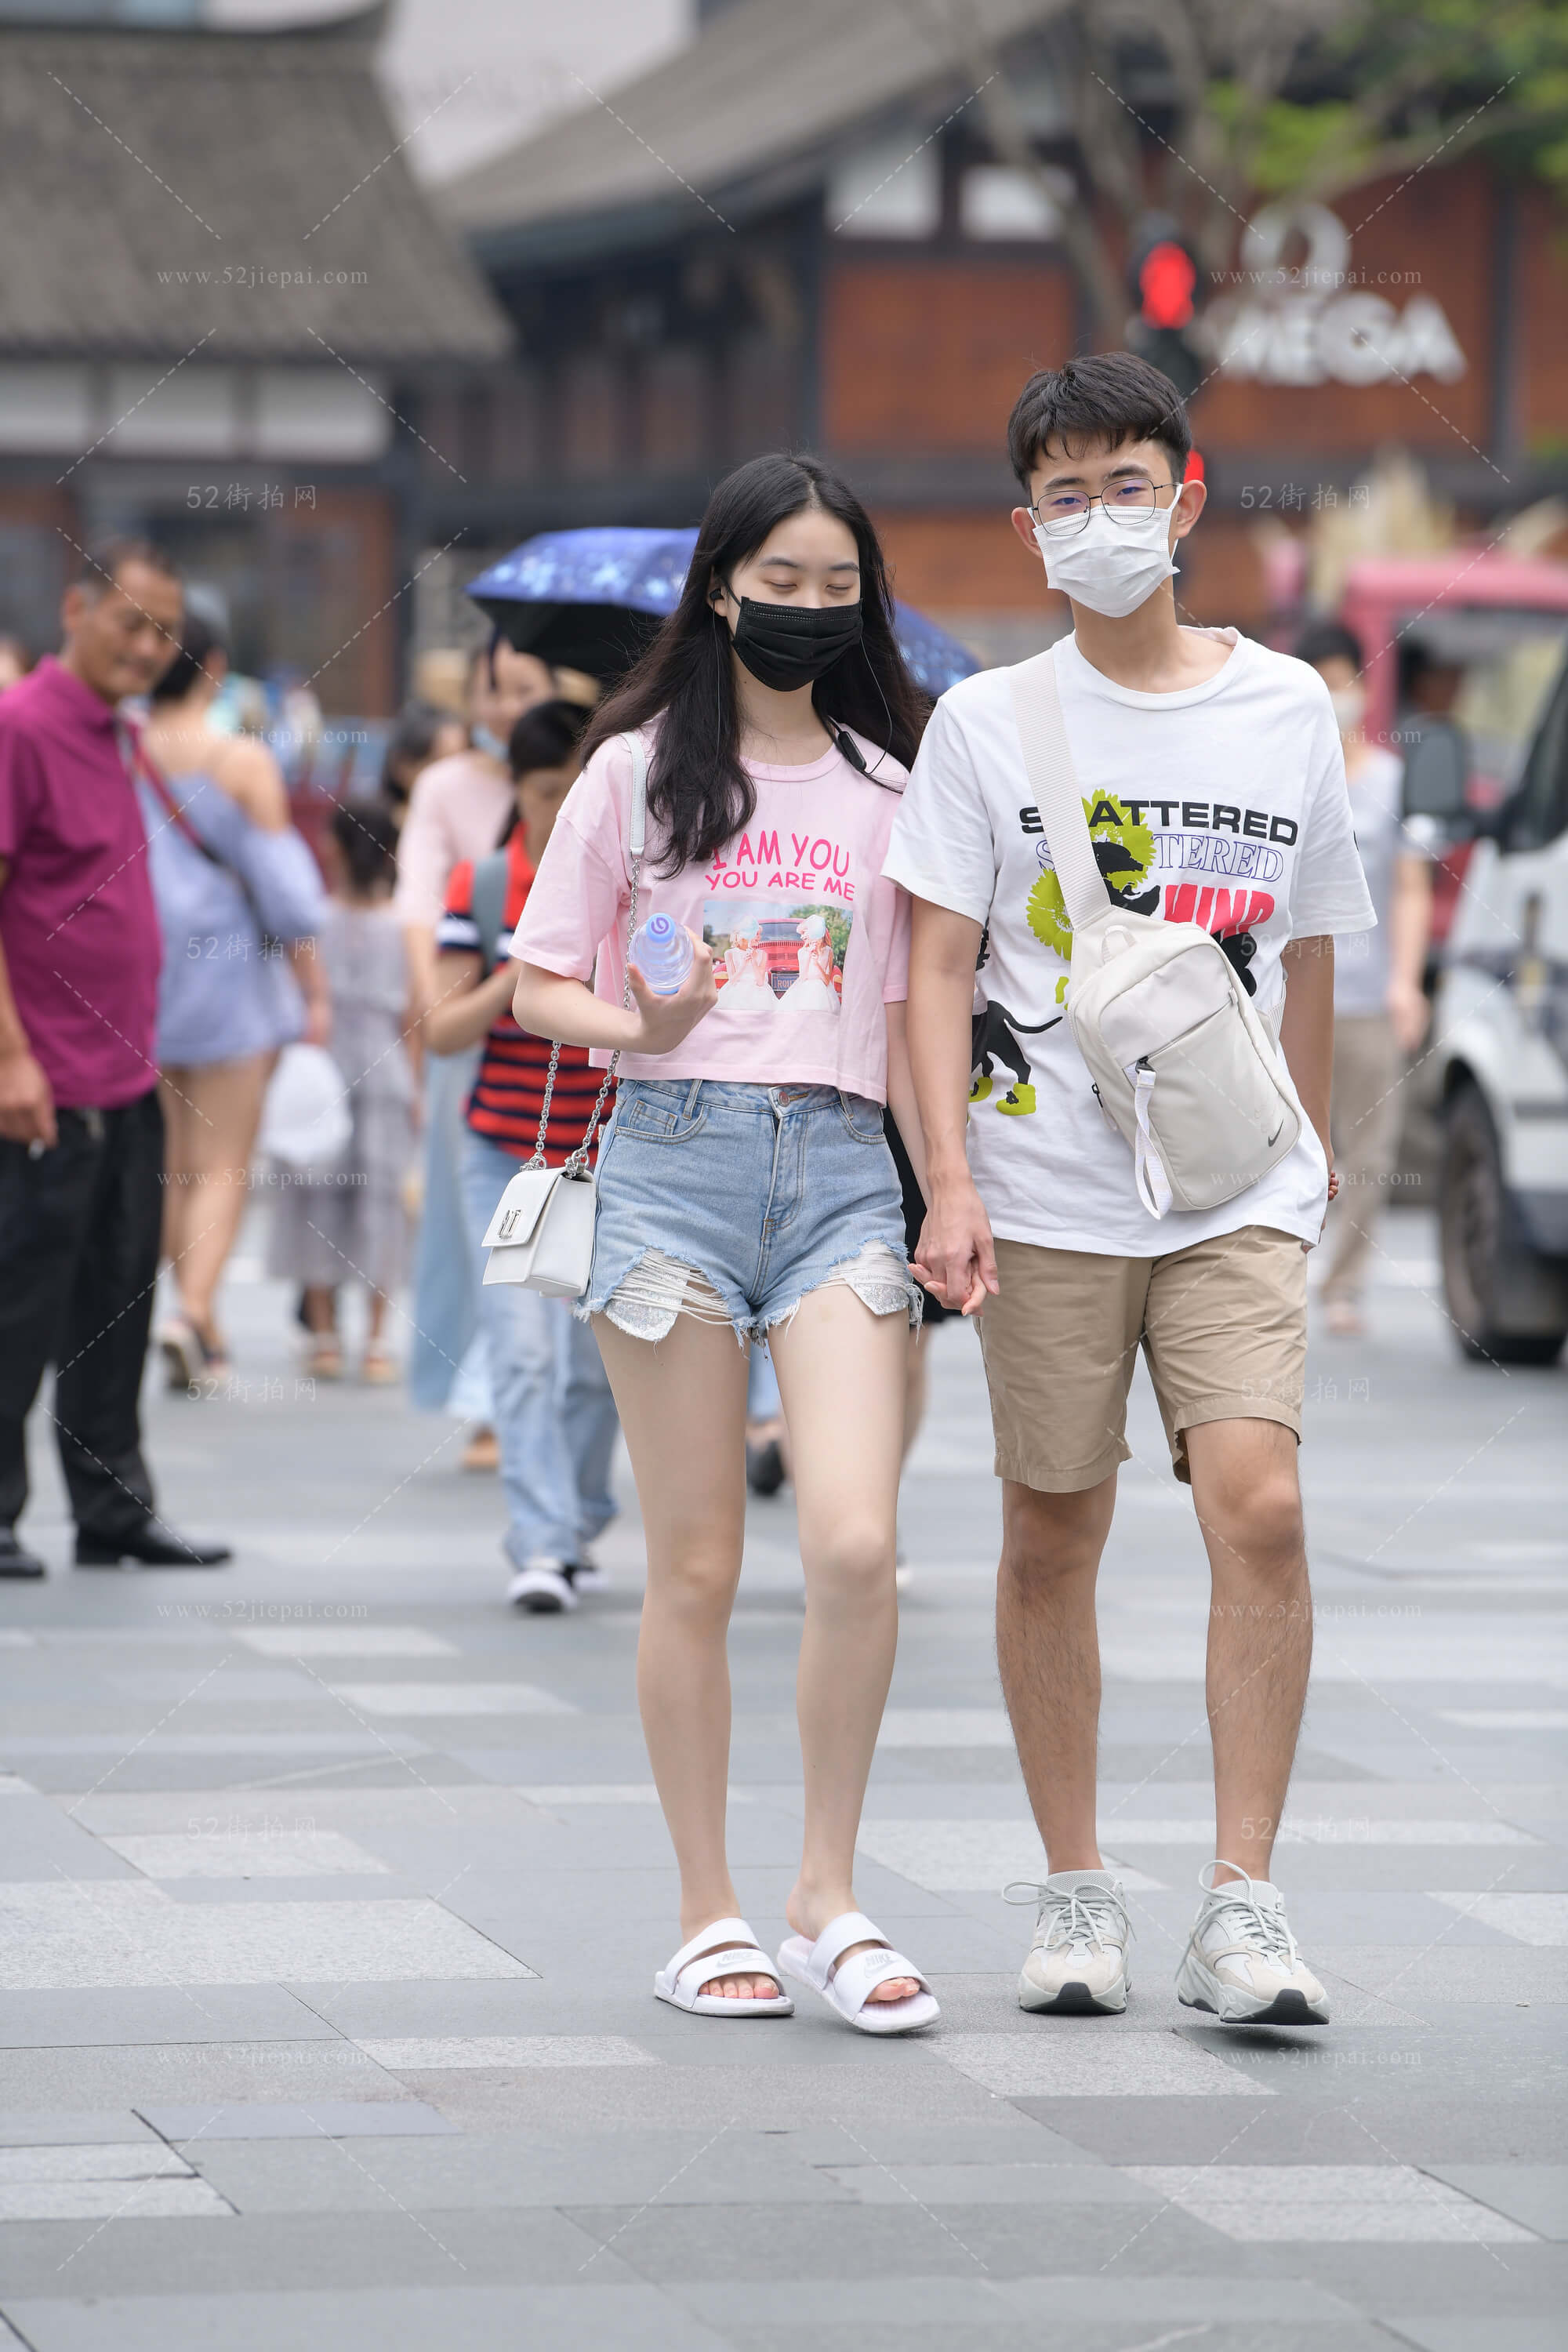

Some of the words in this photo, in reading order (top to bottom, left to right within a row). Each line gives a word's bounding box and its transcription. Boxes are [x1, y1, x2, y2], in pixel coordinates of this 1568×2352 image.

[1019, 800, 1298, 846] SATTERED
[713, 847, 727, 870] I
[736, 830, 782, 866] AM
[791, 833, 849, 877] YOU
[1036, 833, 1283, 882] STERED
[705, 871, 758, 891] YOU
[768, 872, 815, 890] ARE
[823, 877, 855, 901] ME
[866, 1953, 891, 1966] NIKE
